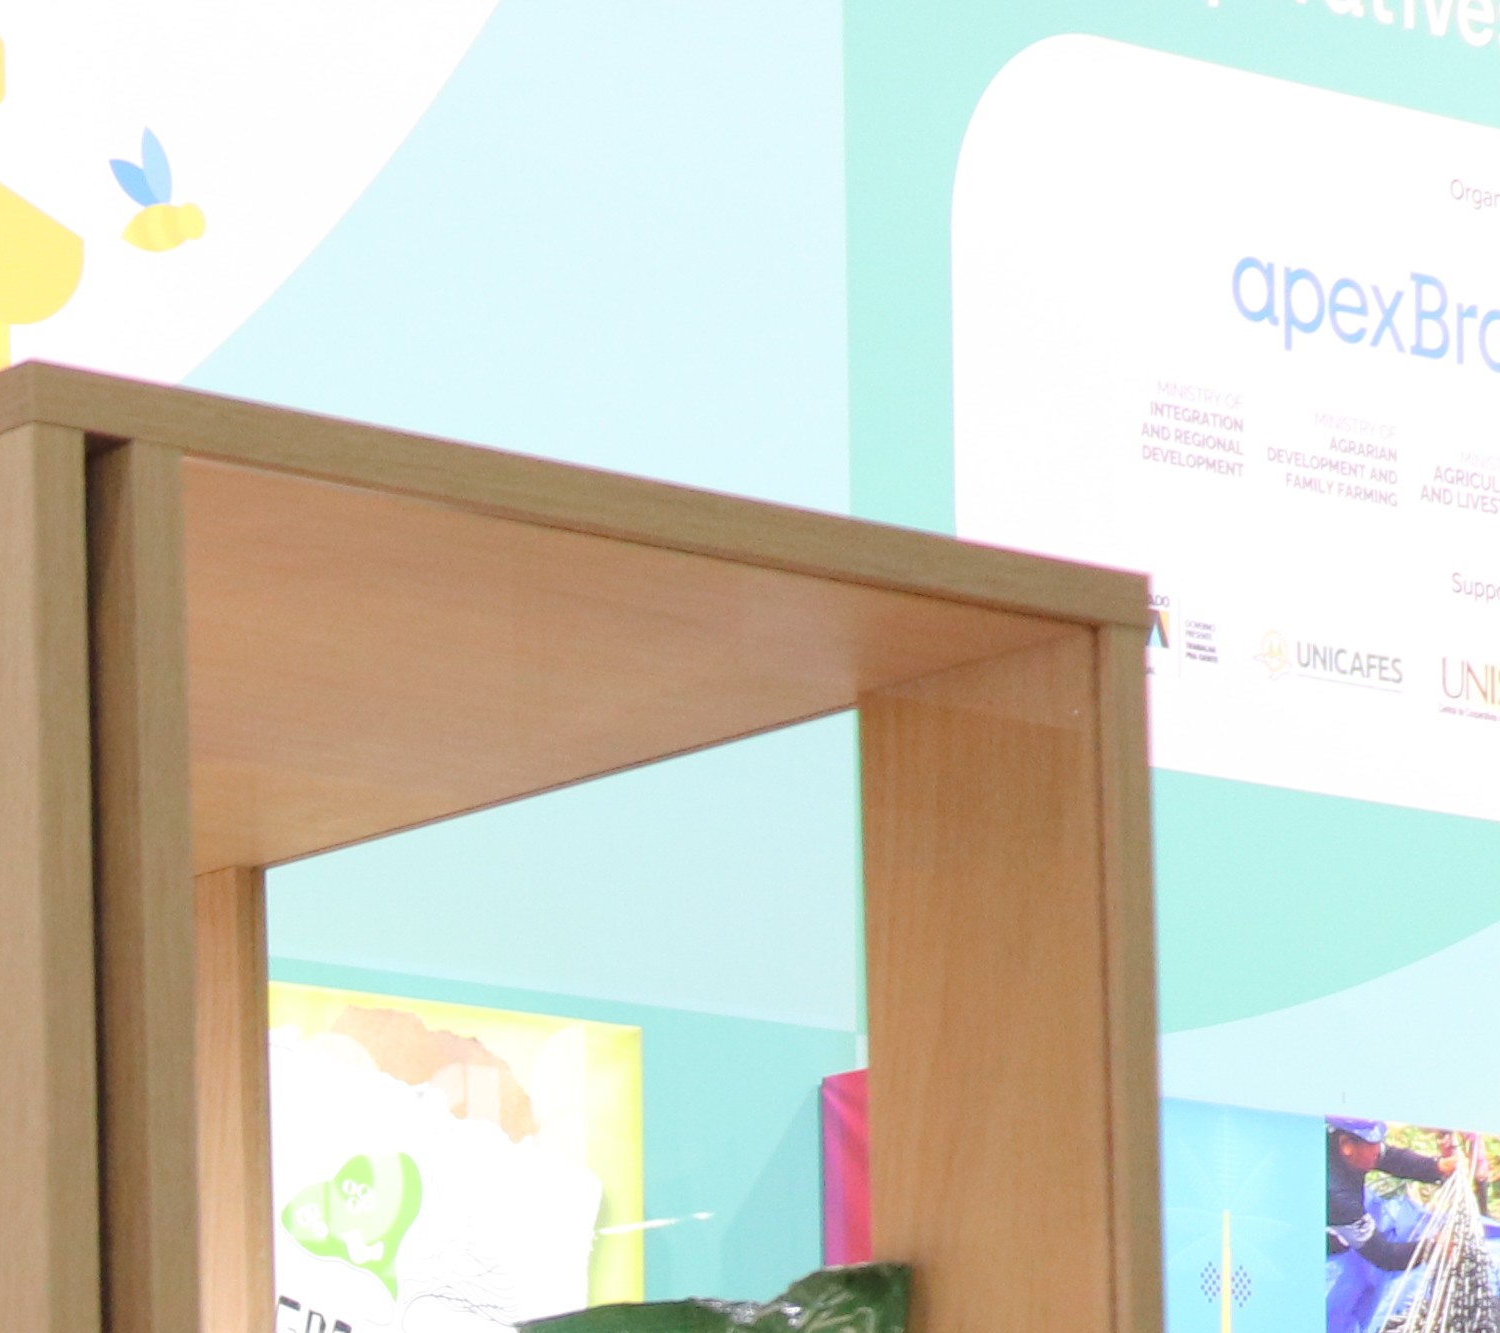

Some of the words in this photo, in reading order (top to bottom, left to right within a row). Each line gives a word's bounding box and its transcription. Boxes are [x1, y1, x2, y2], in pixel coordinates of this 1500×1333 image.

[1150, 401, 1244, 433] INTEGRATION
[1141, 422, 1171, 440] AND
[1174, 428, 1244, 456] REGIONAL
[1329, 436, 1398, 463] AGRARIAN
[1142, 445, 1244, 478] DEVELOPMENT
[1267, 446, 1366, 479] DEVELOPMENT
[1369, 466, 1398, 485] AND
[1285, 472, 1334, 496] FAMILY
[1337, 482, 1398, 507] FARMING
[1432, 464, 1500, 493] AGRICUL
[1420, 484, 1454, 505] AND
[1456, 490, 1500, 515] LIVES
[1296, 640, 1404, 685] UNICAFES
